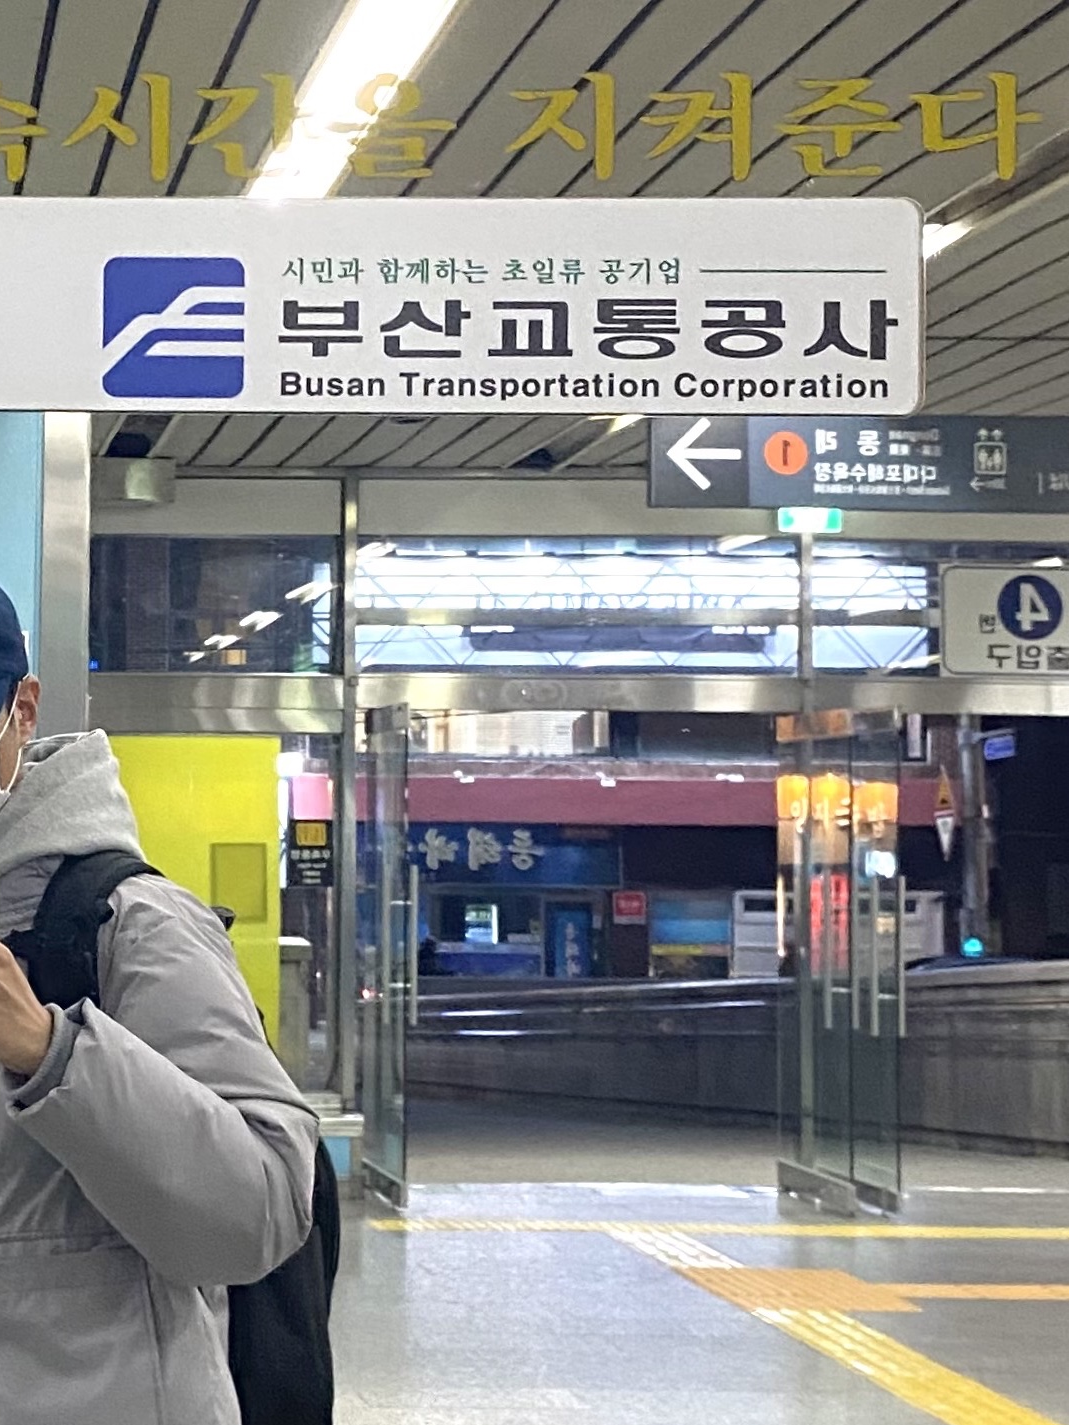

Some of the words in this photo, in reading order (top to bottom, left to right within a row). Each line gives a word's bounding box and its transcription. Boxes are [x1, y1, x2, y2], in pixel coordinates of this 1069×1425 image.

[507, 69, 1045, 182] 지켜준다
[281, 258, 365, 286] 시민과
[378, 258, 491, 286] 함께하는
[501, 258, 585, 286] 초일류
[599, 258, 684, 286] 공기업
[277, 297, 900, 362] 부산교통공사
[279, 371, 388, 400] Busan
[398, 371, 663, 403] Transportation
[672, 371, 890, 403] Corporation
